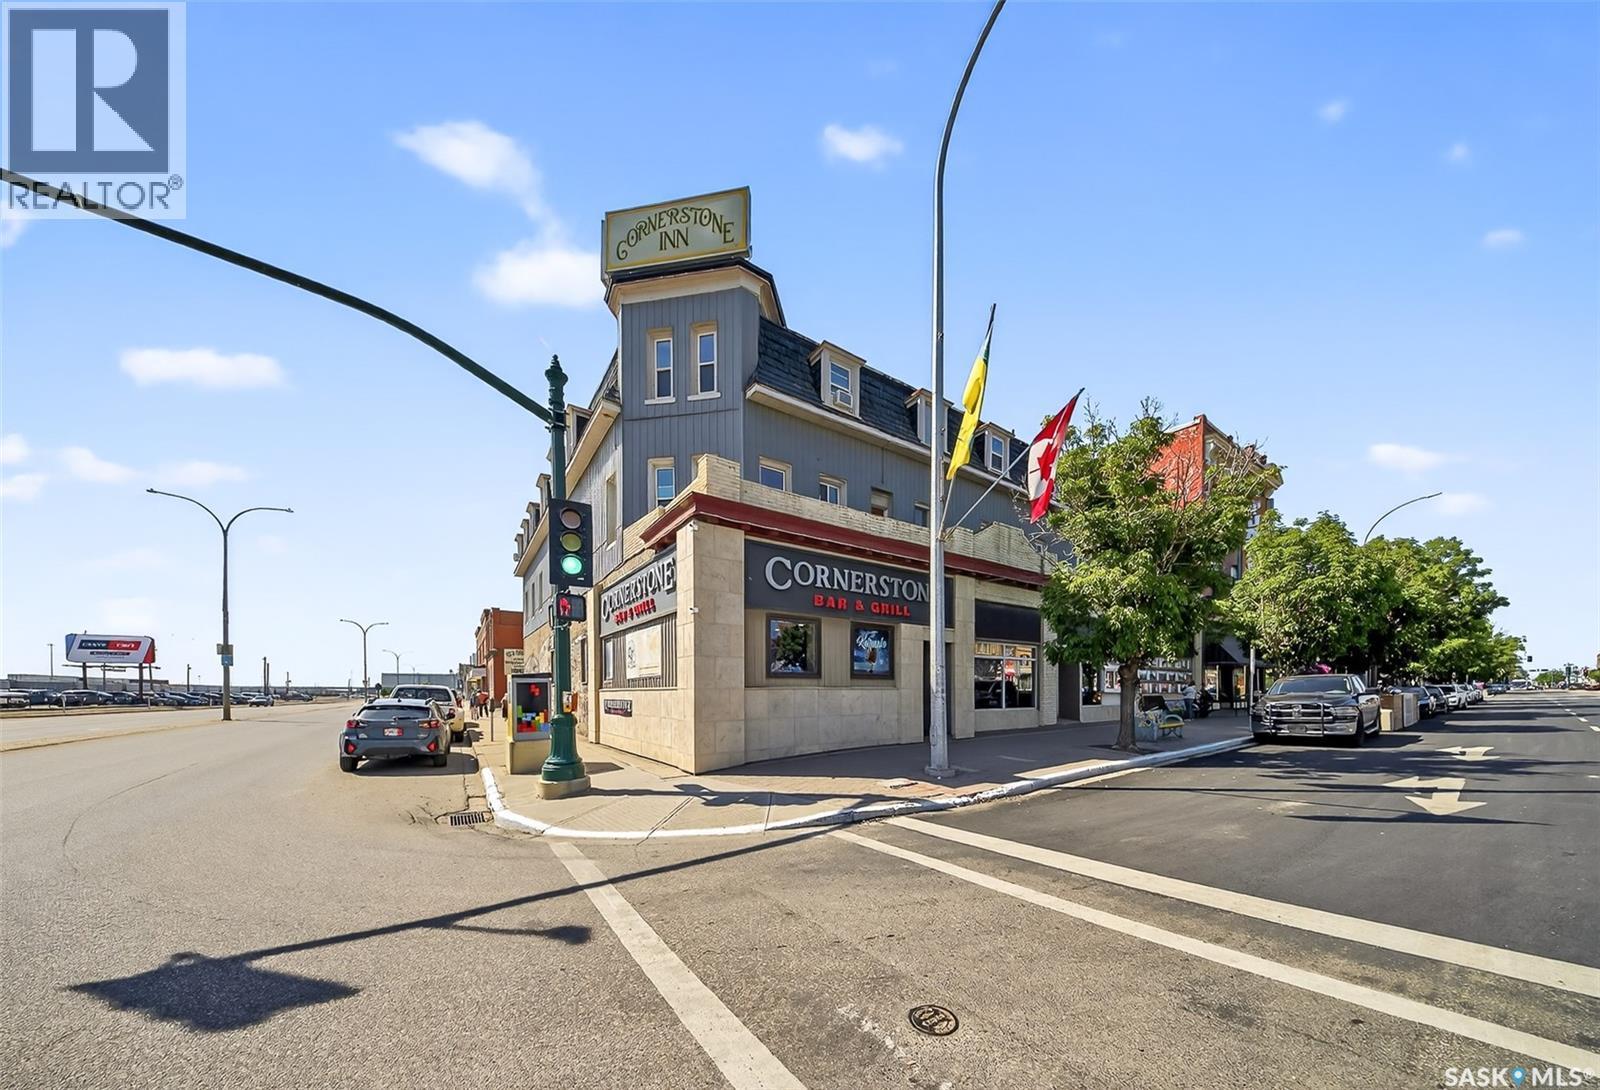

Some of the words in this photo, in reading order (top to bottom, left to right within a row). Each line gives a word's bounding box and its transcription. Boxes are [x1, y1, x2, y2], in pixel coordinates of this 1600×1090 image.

[616, 206, 735, 261] CORNERSTONE
[659, 227, 689, 251] INN
[765, 556, 929, 602] CORNERSTON
[813, 594, 848, 610] BAR
[855, 600, 865, 611] &
[871, 602, 911, 617] GRILL
